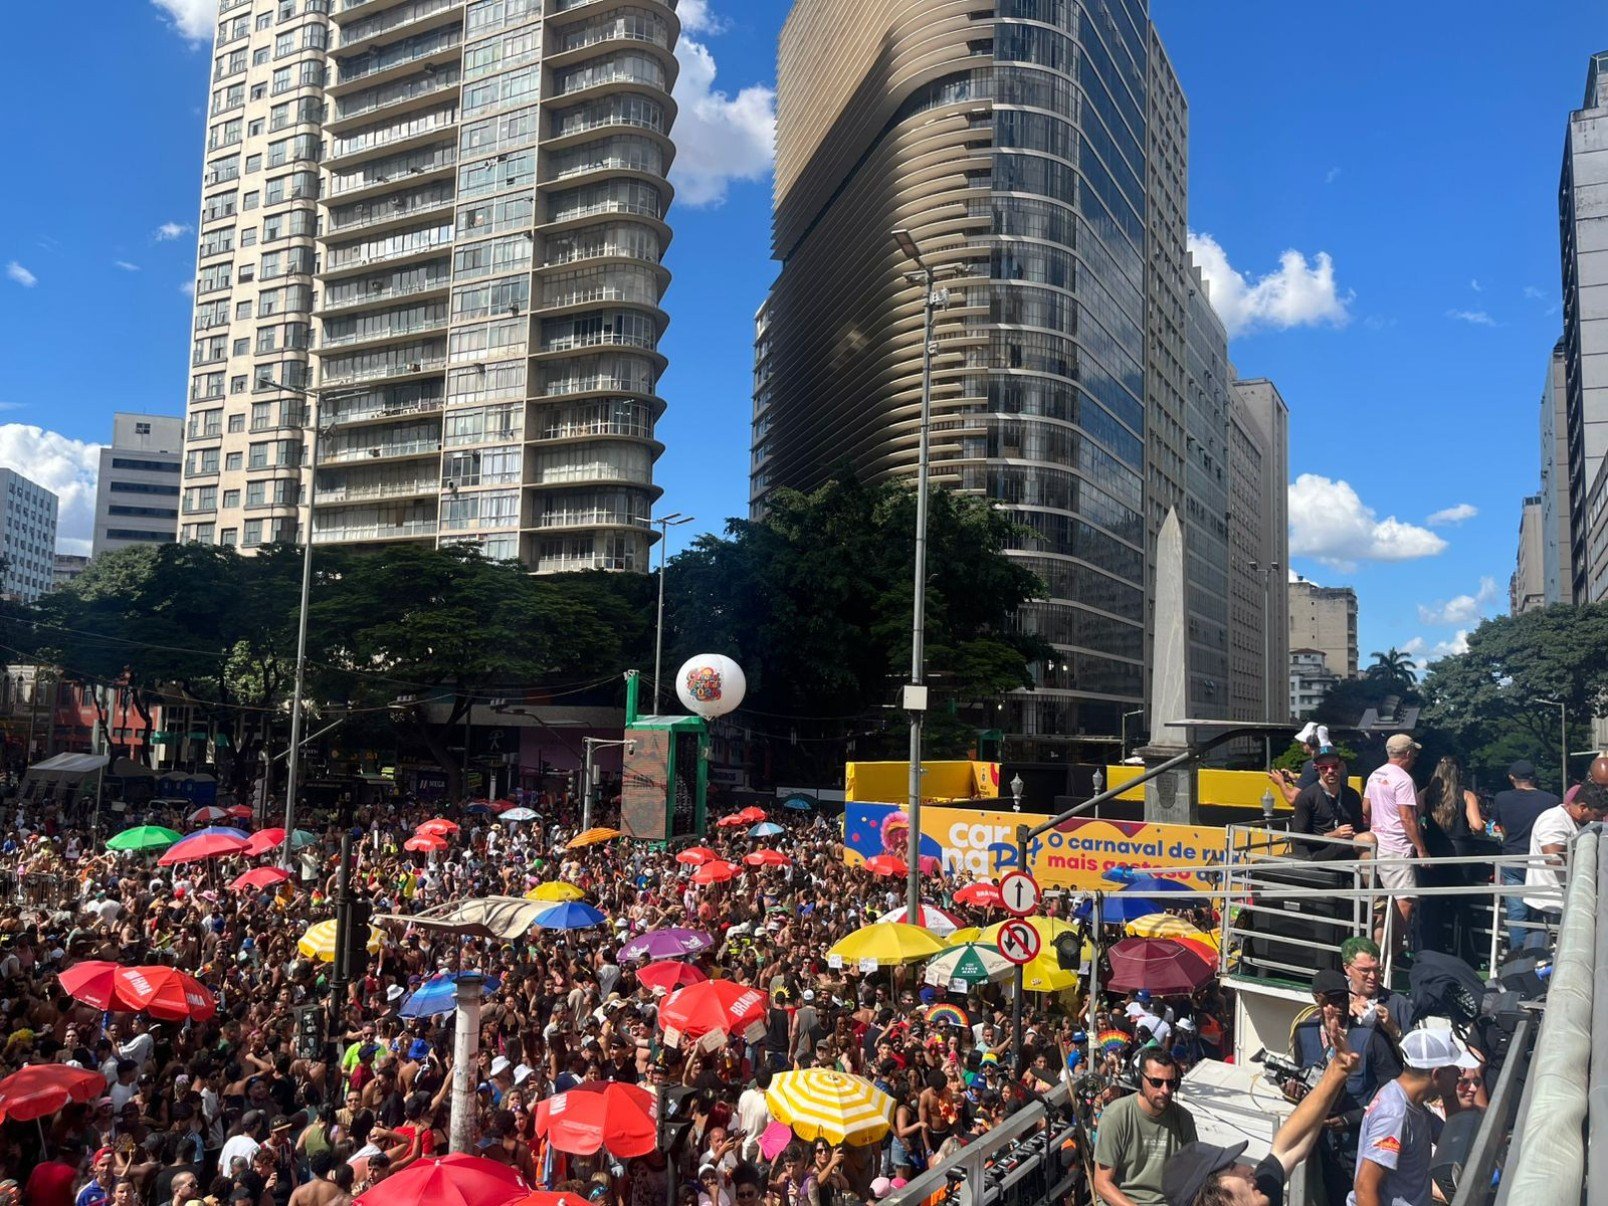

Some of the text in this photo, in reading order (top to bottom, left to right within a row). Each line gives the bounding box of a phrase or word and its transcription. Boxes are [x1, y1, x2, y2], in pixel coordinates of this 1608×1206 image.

[949, 822, 1012, 850] car
[1047, 832, 1064, 849] O
[1068, 836, 1164, 858] carnaval
[1168, 841, 1197, 860] de
[1047, 853, 1099, 871] mais
